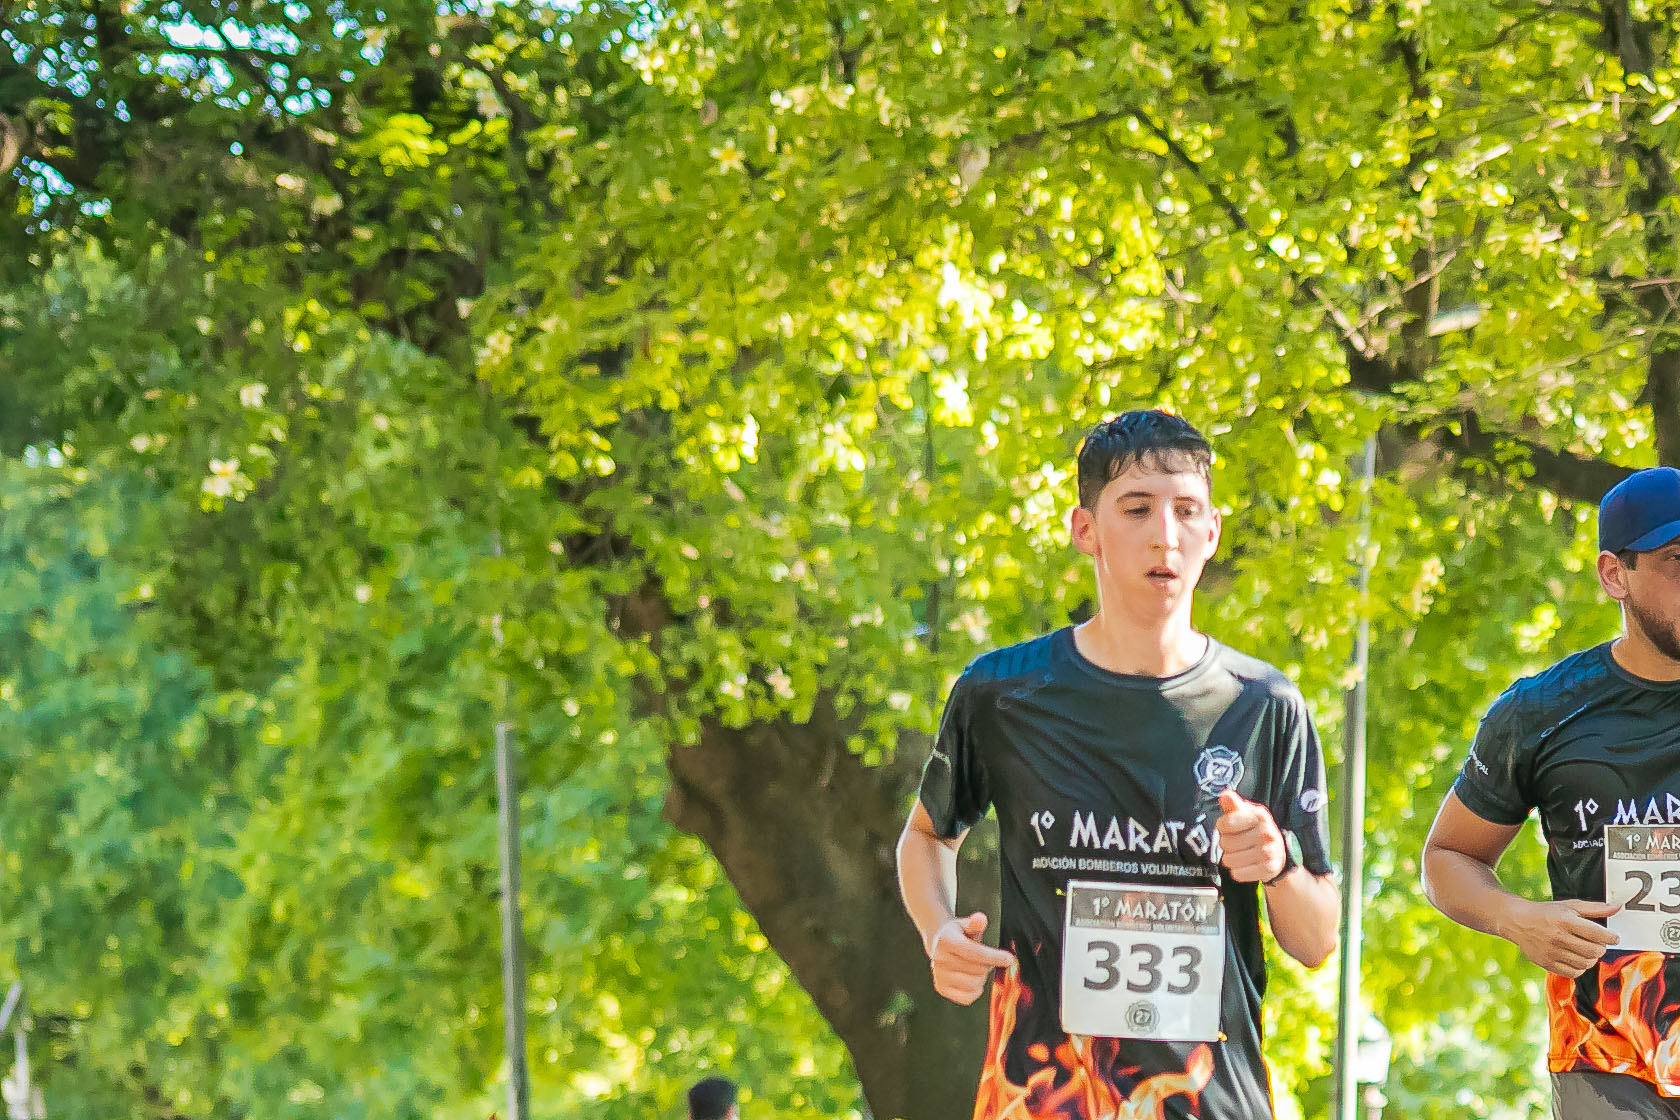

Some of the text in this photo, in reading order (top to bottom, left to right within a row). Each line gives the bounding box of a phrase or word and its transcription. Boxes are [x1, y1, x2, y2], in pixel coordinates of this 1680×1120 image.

[1078, 858, 1139, 875] BOMBEROS
[1114, 897, 1208, 922] MARATÓN
[1083, 940, 1203, 995] 333
